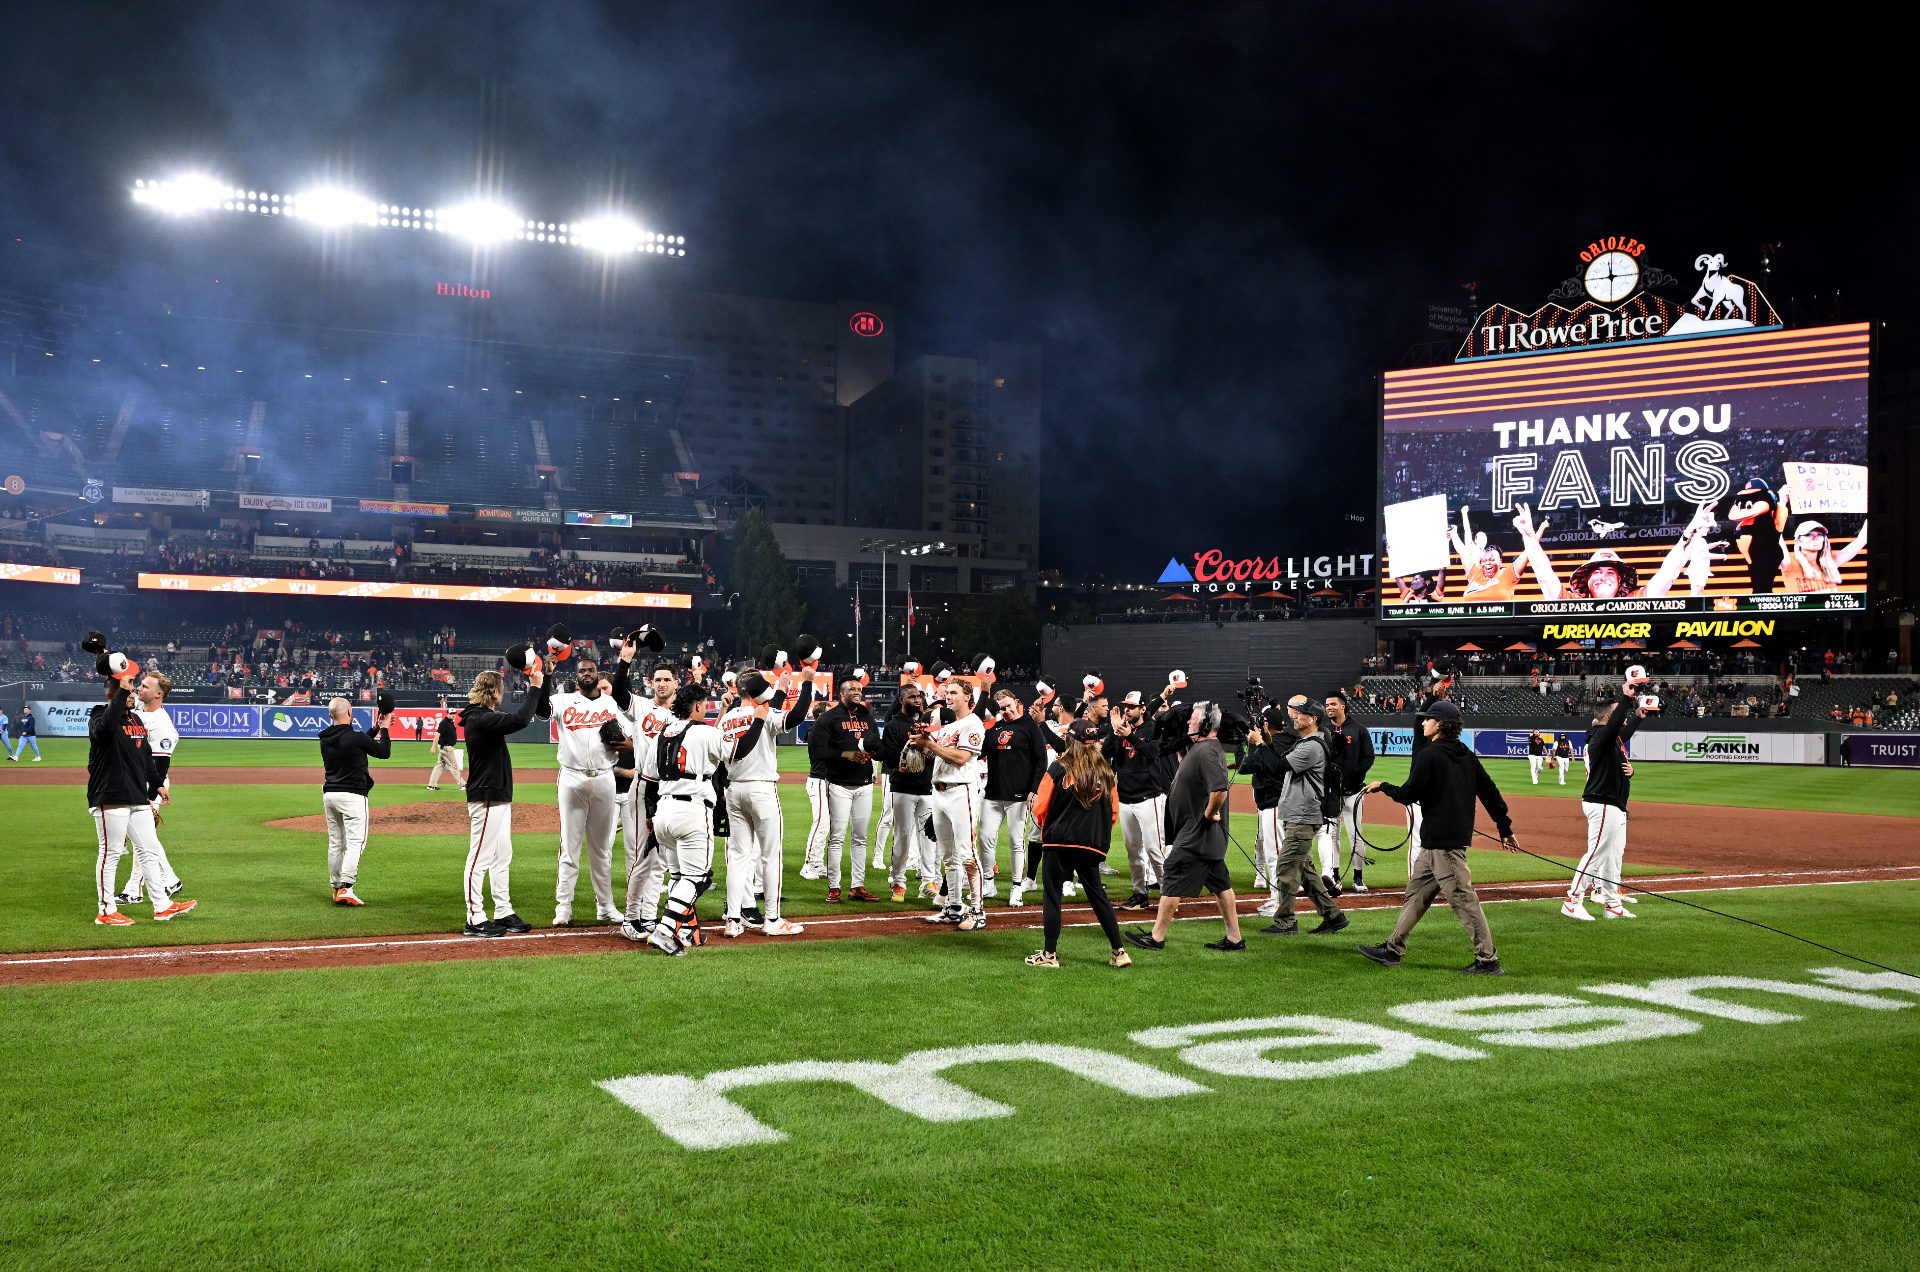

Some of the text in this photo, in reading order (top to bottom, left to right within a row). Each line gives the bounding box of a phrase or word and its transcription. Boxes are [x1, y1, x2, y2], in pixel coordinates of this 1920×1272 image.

[1580, 236, 1646, 263] ORIOLES
[437, 282, 491, 299] Hilton
[1429, 305, 1461, 315] University
[1437, 314, 1468, 324] Maryland
[1428, 323, 1473, 333] Medical Syst
[1493, 403, 1731, 448] THANK YOU
[1492, 440, 1730, 513] FANS
[1798, 465, 1851, 477] DO YOU
[11, 479, 18, 490] 8
[85, 488, 99, 499] 42
[243, 498, 263, 507] ENJOY
[294, 500, 304, 509] ICE
[306, 501, 328, 510] CREAM
[1559, 532, 1599, 542] ORIOLE
[1605, 530, 1627, 540] ARK
[1638, 526, 1684, 538] CAMDEN
[1194, 549, 1375, 582] Coors LIGHT
[53, 571, 79, 583] WIN
[1192, 579, 1333, 593] ROOF DECK
[160, 578, 669, 607] WIN WIN WIN WIN WIN
[1447, 606, 1465, 616] E/NE
[1530, 603, 1567, 613] ORIOLE
[1568, 602, 1594, 612] PARK
[1606, 601, 1651, 611] CAMDEN
[1652, 600, 1686, 610] YARDS
[1757, 602, 1799, 610] 13004141
[1543, 620, 1775, 640] PUREWAGER PAVILION
[176, 711, 251, 727] ECOM
[294, 716, 363, 728] VANA
[1870, 744, 1917, 756] TRUIST
